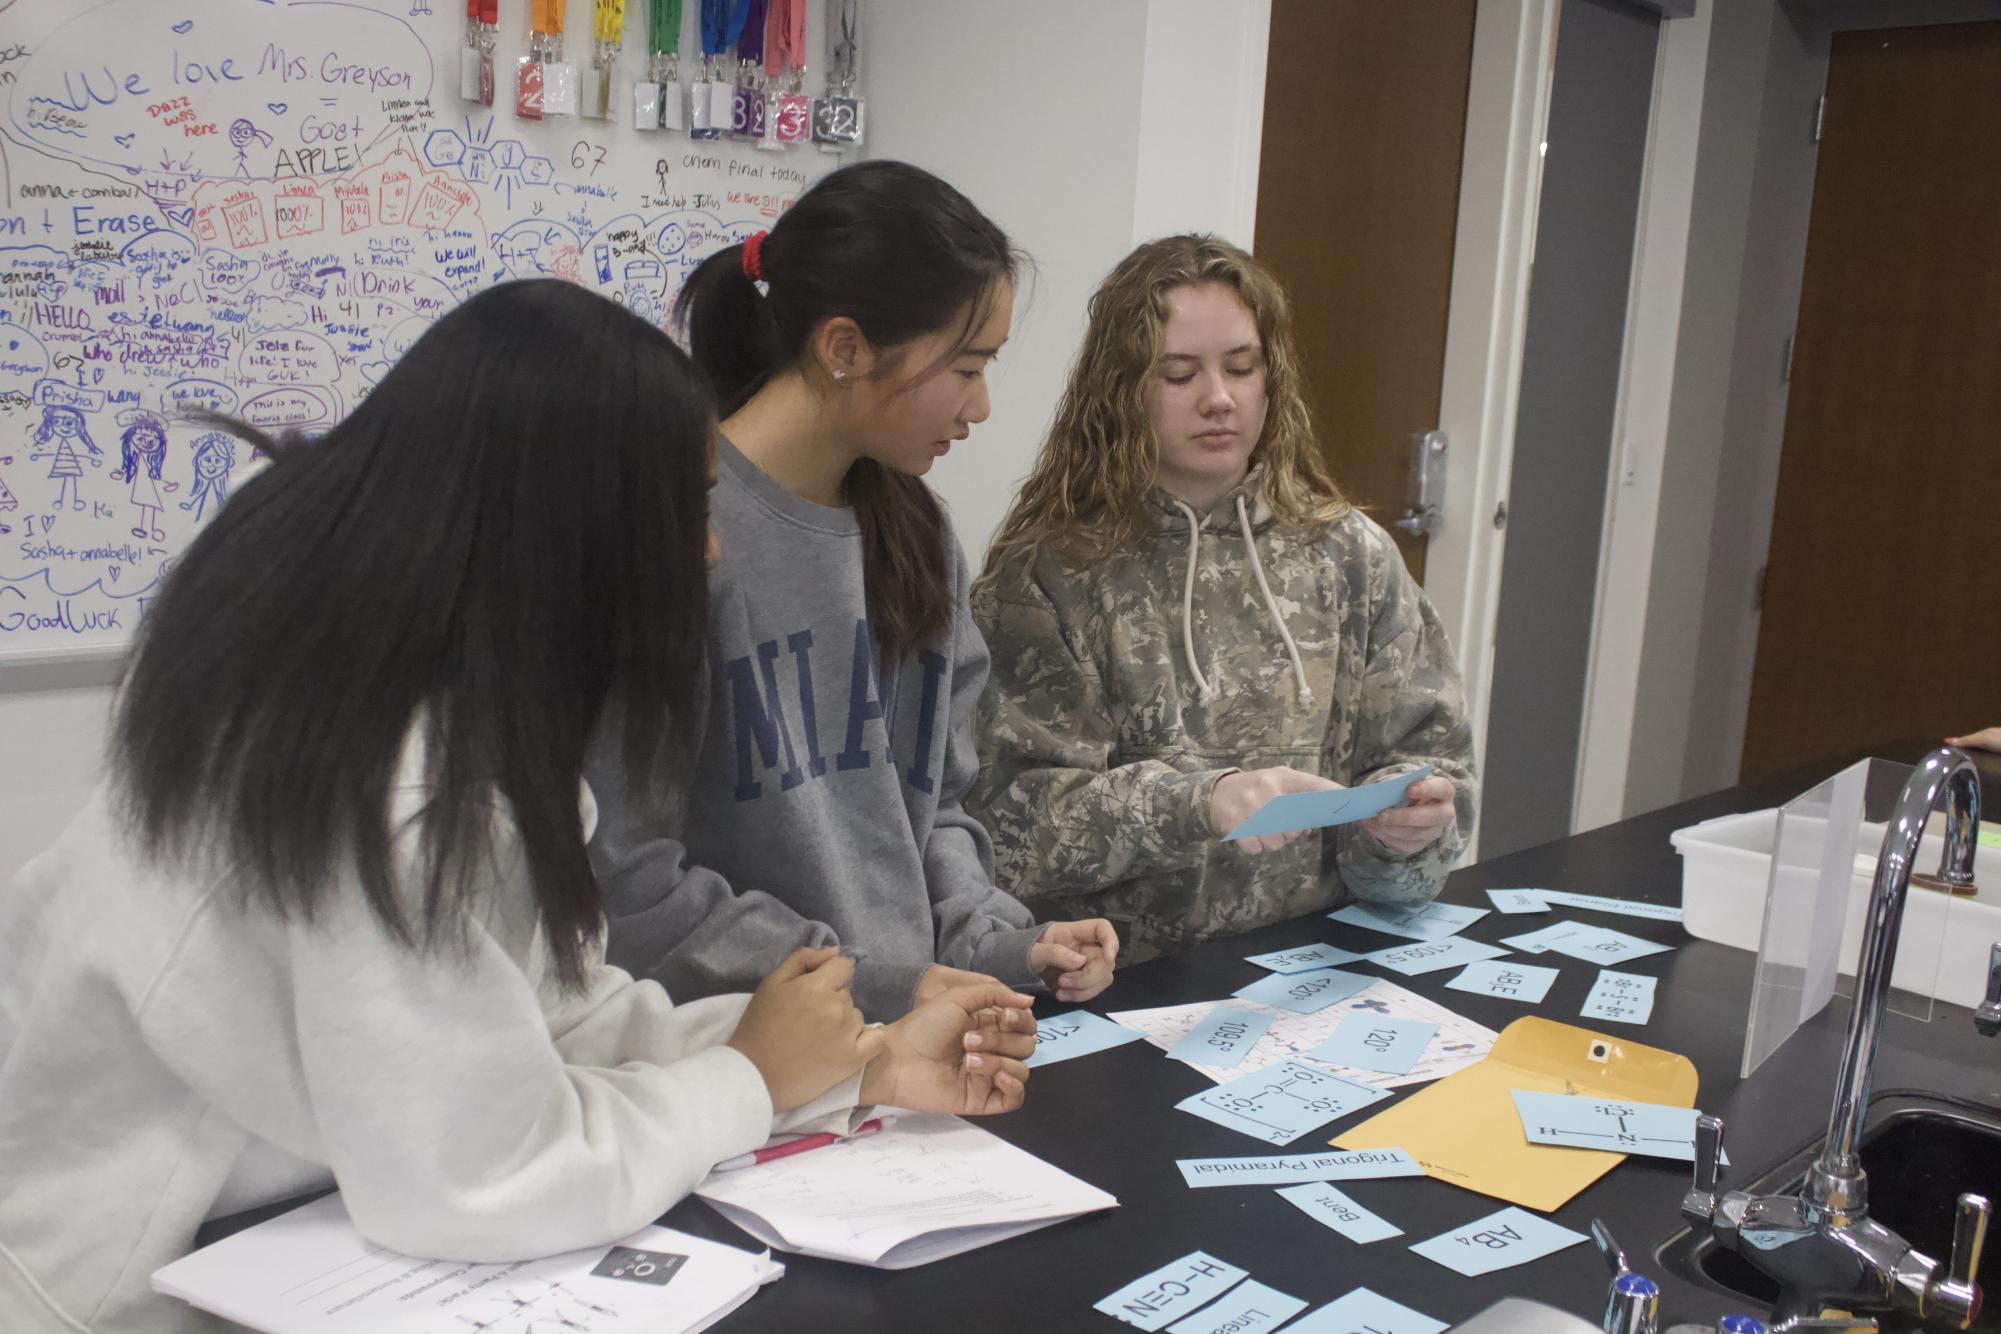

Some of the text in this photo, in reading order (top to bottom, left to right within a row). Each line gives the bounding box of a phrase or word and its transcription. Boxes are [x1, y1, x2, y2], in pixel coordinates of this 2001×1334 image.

[64, 42, 411, 111] We love Mrs. Greyson
[184, 123, 218, 137] here
[571, 140, 607, 177] 67
[729, 160, 764, 177] final
[531, 168, 542, 180] S
[73, 206, 158, 235] Erase
[205, 255, 249, 271] Sasha
[42, 385, 94, 407] Prisha
[1363, 1028, 1399, 1053] 120°
[1193, 1158, 1308, 1175] Pyramidal
[1313, 1151, 1406, 1170] Trigonal
[1315, 1195, 1361, 1222] Bent
